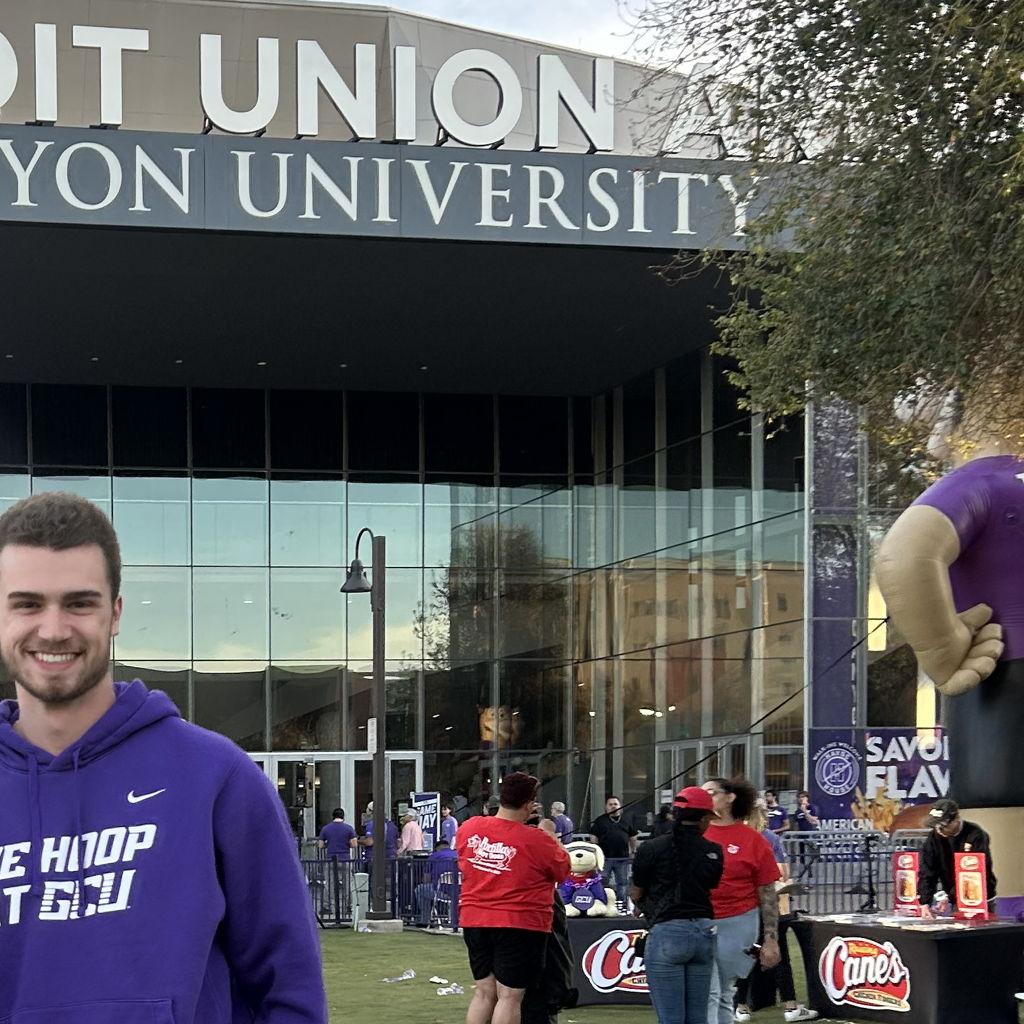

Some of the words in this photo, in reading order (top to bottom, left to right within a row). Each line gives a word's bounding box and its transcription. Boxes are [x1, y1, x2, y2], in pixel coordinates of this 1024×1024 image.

[200, 33, 615, 152] UNION
[230, 150, 768, 237] UNIVERSITY
[41, 824, 157, 873] HOOP
[816, 818, 874, 831] AMERICAN
[38, 869, 137, 920] GCU
[575, 895, 593, 904] GCU
